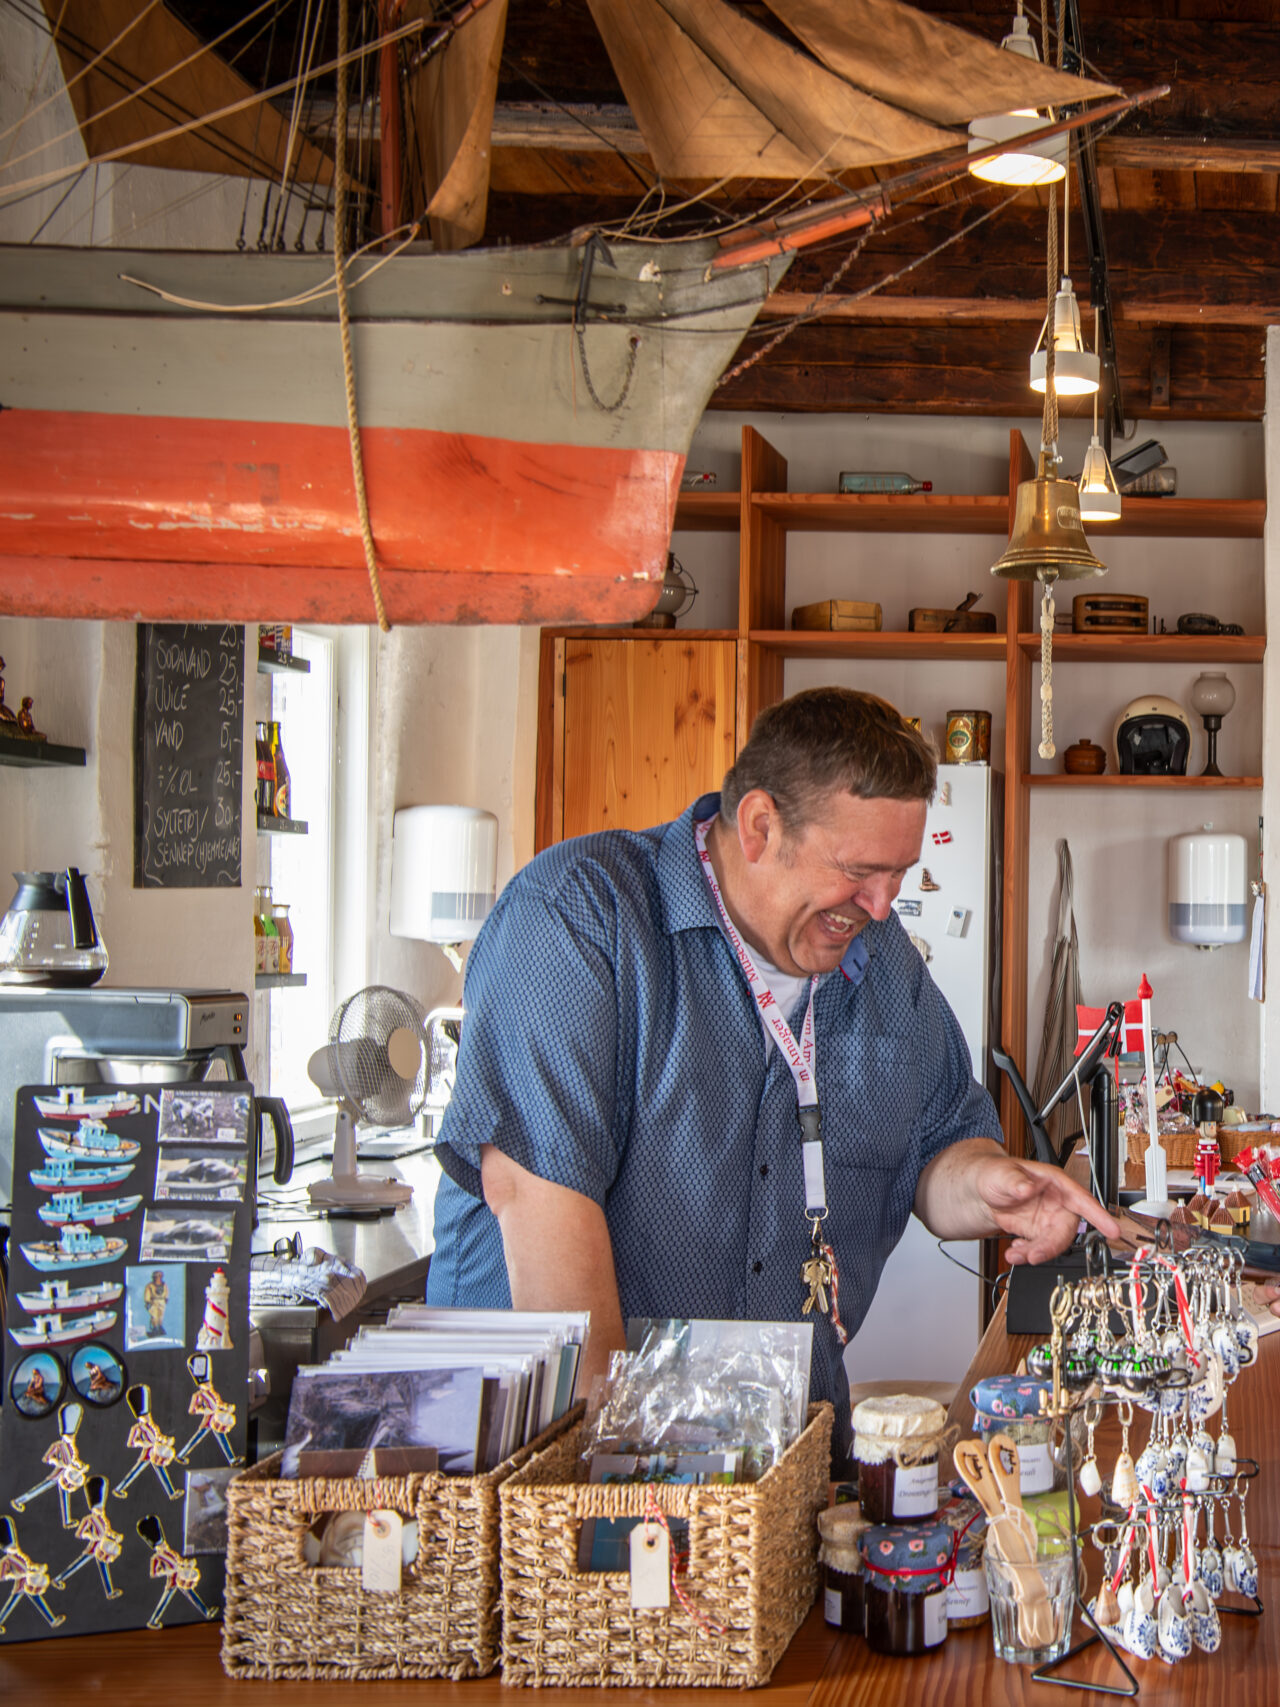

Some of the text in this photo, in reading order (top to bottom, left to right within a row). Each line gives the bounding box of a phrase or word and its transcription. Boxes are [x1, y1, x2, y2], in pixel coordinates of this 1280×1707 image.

[156, 640, 211, 679] SODAVAND
[155, 718, 184, 751] VAND
[771, 1017, 804, 1068] Amager
